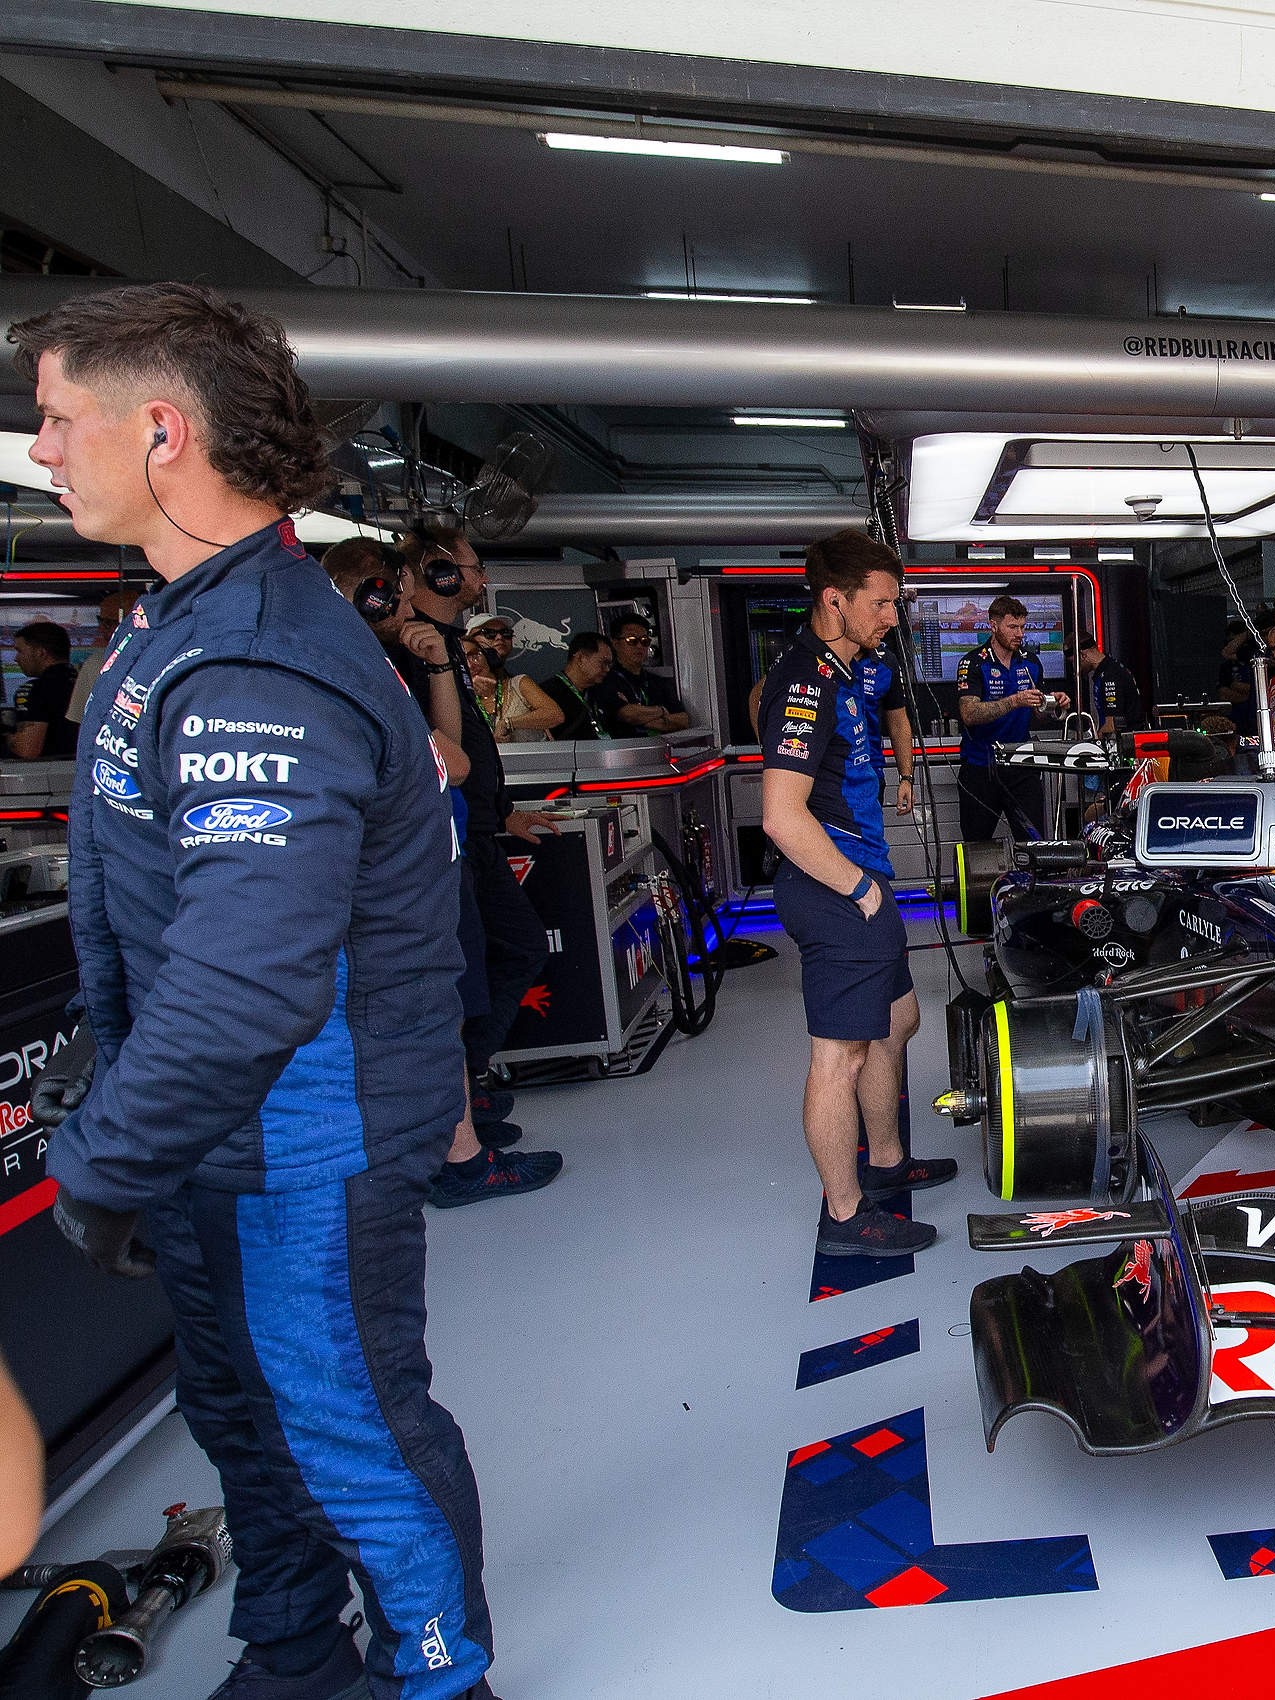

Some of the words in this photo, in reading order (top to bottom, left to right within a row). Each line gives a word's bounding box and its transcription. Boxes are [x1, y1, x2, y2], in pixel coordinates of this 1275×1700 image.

[787, 695, 804, 705] Hard
[788, 683, 821, 698] Mobil
[206, 718, 306, 740] 1Password
[178, 751, 300, 784] ROKT
[203, 803, 272, 830] Ford
[1157, 816, 1245, 830] ORACLE
[179, 831, 288, 850] RACING
[1179, 908, 1222, 945] CARLYLE
[1092, 946, 1115, 958] Hard
[1114, 946, 1136, 961] Rock
[0, 1100, 34, 1139] Re
